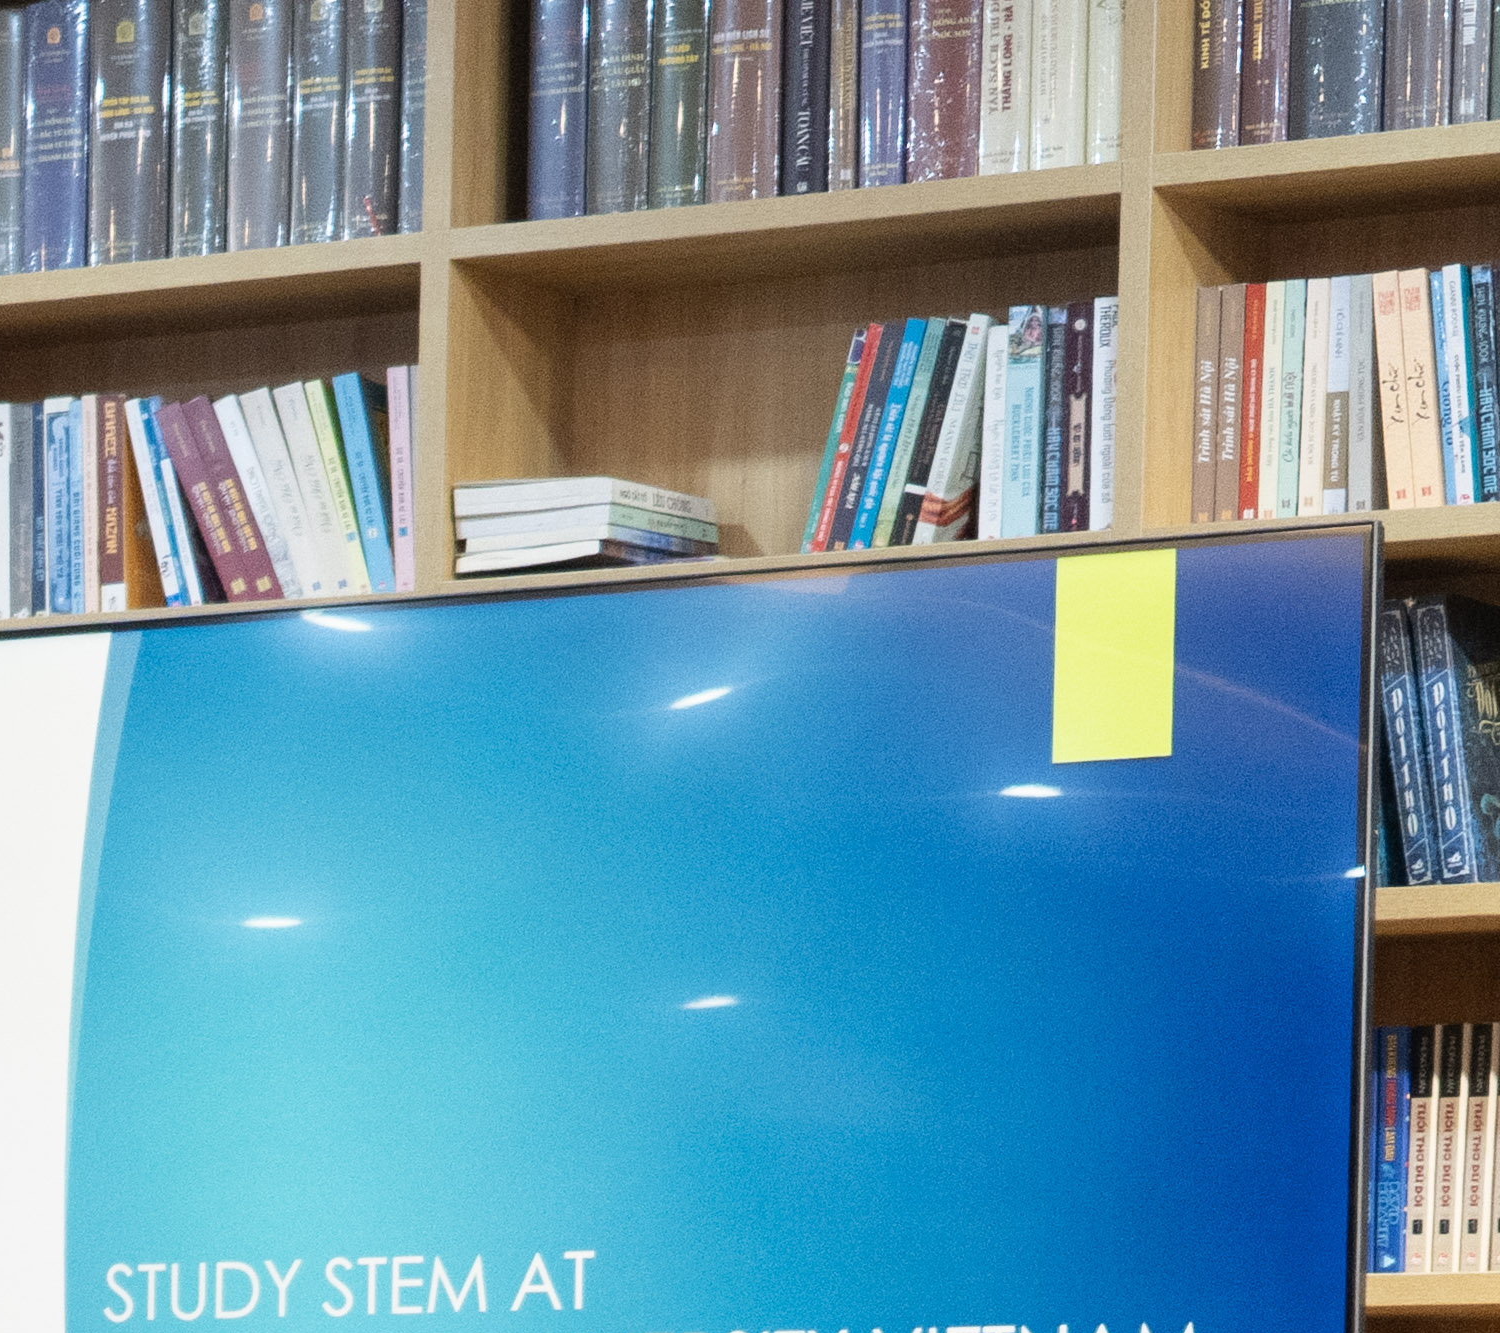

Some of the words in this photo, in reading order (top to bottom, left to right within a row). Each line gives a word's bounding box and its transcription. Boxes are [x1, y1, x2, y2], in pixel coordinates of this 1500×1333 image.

[102, 1257, 303, 1324] STUDY
[320, 1254, 488, 1319] STEM
[509, 1249, 596, 1313] AT
